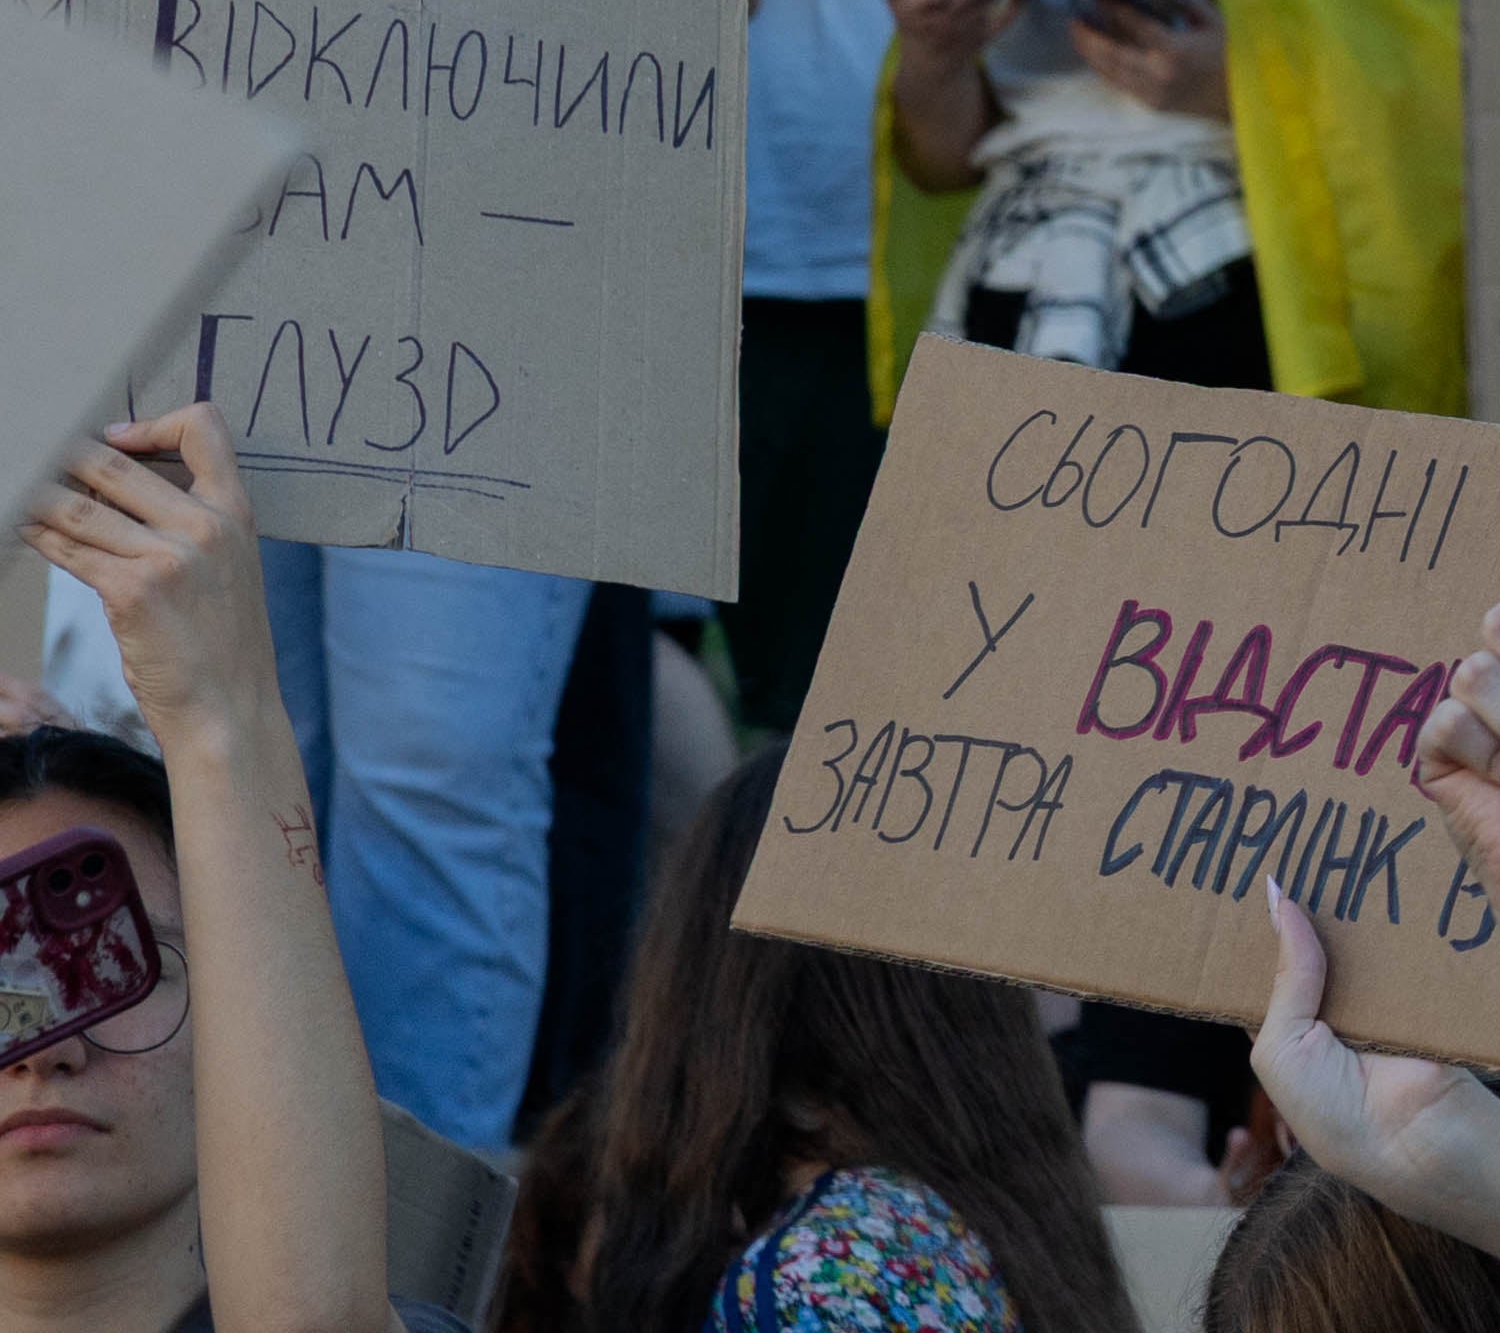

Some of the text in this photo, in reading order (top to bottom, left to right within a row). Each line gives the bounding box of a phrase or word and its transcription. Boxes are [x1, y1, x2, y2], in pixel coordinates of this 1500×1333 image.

[240, 149, 424, 248] АМ
[985, 408, 1469, 571] СЬОГОДНІ
[942, 579, 1462, 800] У ВІДСТА
[782, 718, 1074, 862] ЗАВТРА
[1098, 767, 1426, 926] СТАРЛІНК
